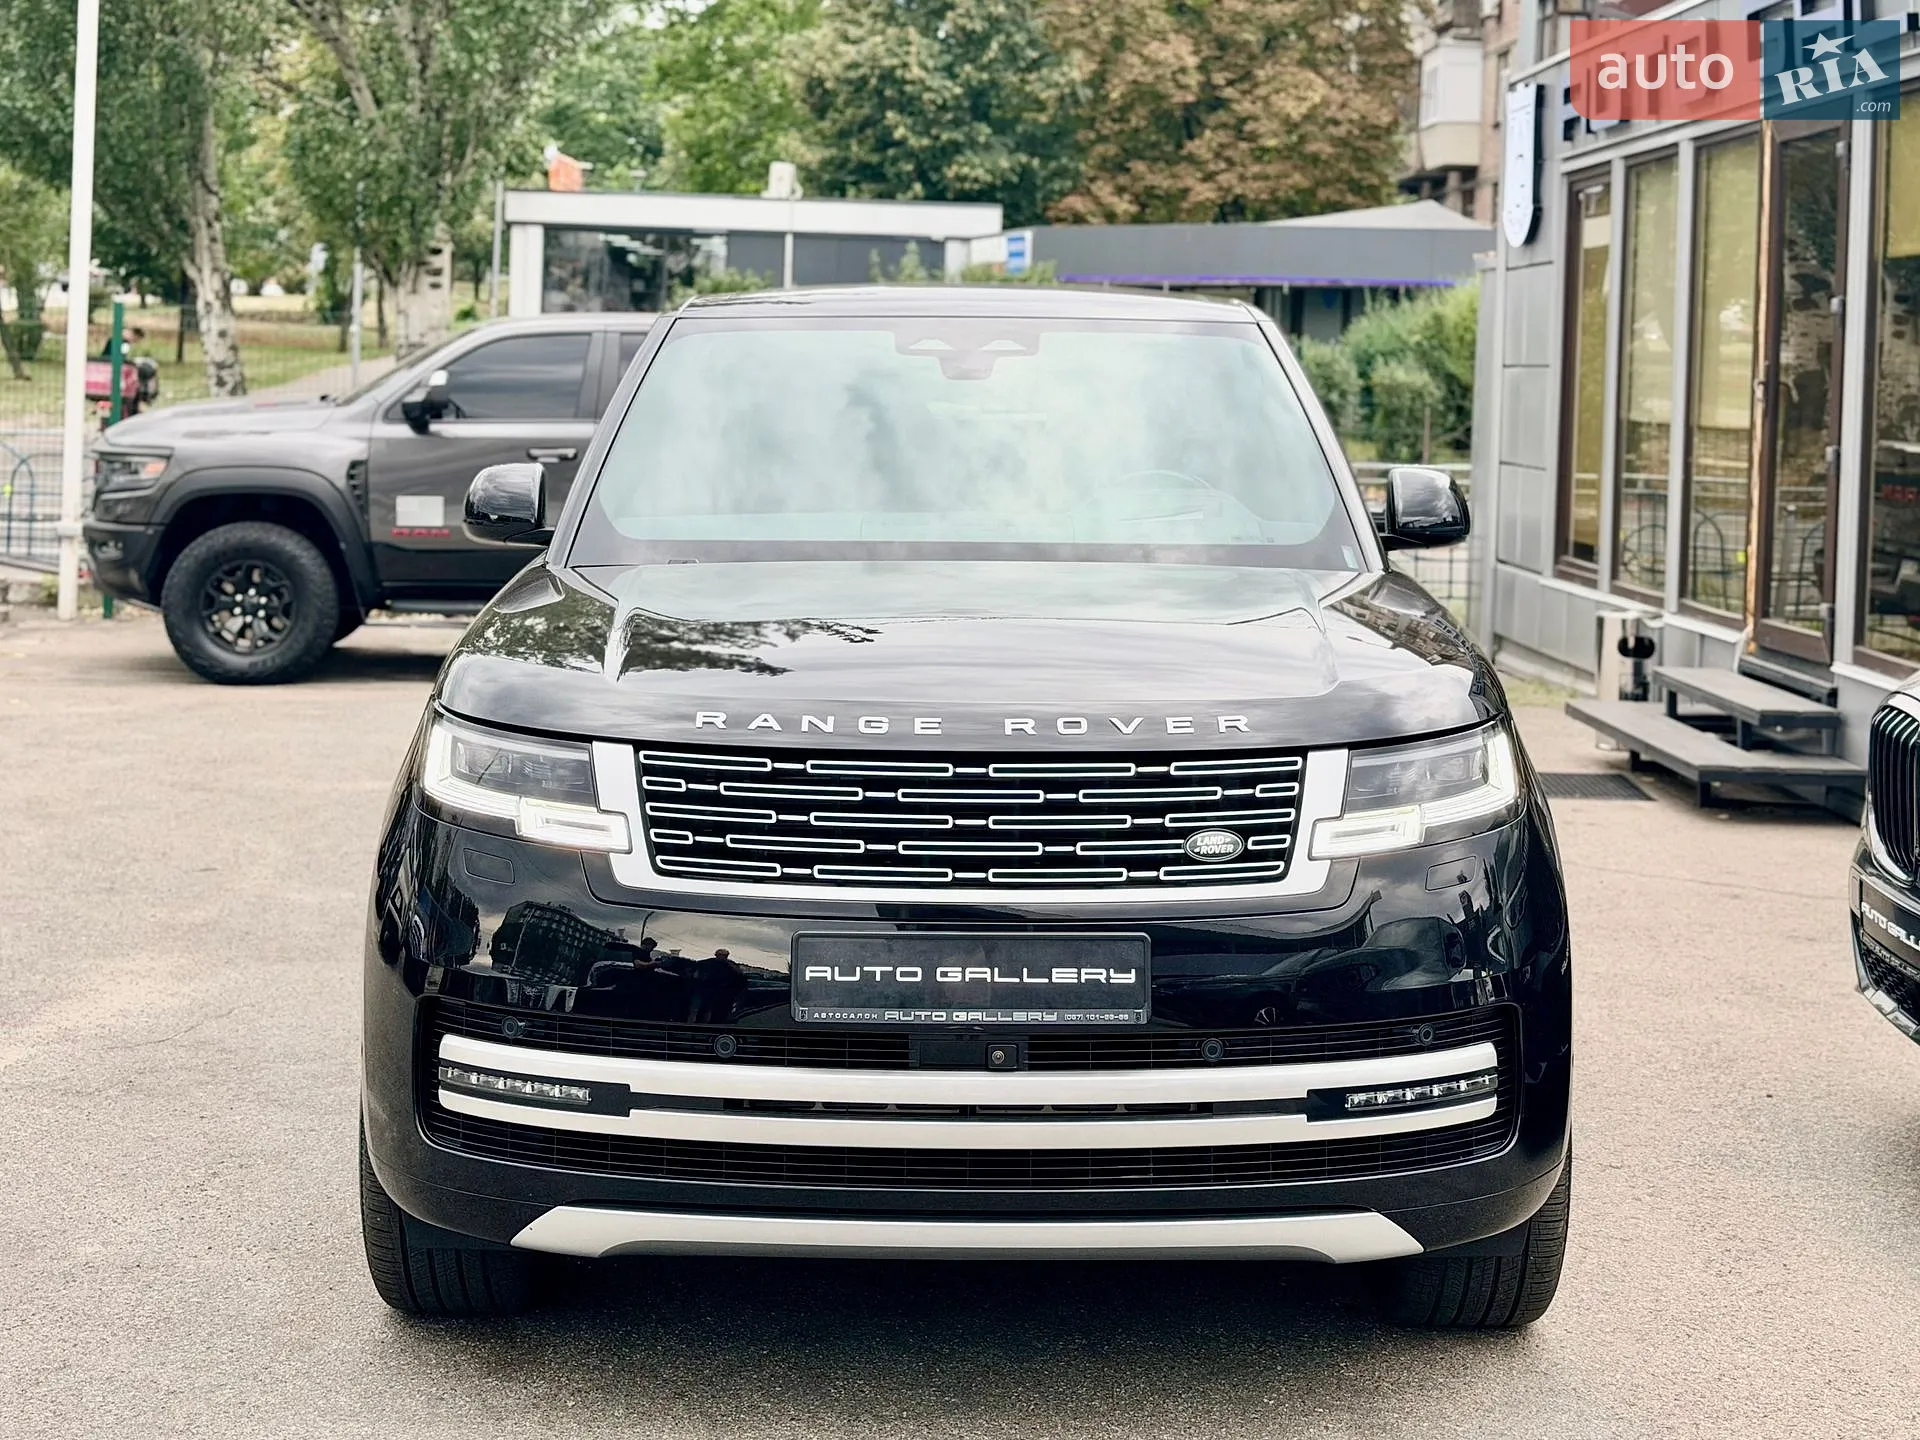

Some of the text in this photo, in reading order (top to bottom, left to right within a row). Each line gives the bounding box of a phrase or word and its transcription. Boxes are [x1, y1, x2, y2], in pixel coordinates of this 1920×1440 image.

[695, 711, 1251, 735] RANGE ROVER
[1197, 835, 1225, 845] LAND
[1200, 844, 1234, 854] ROVER
[1861, 901, 1888, 930] AUTO
[805, 966, 1136, 983] AUTO GALLERY
[813, 1012, 878, 1020] АВТОСАЛОН
[884, 1011, 946, 1021] AUTO
[952, 1011, 1058, 1021] GALLERY
